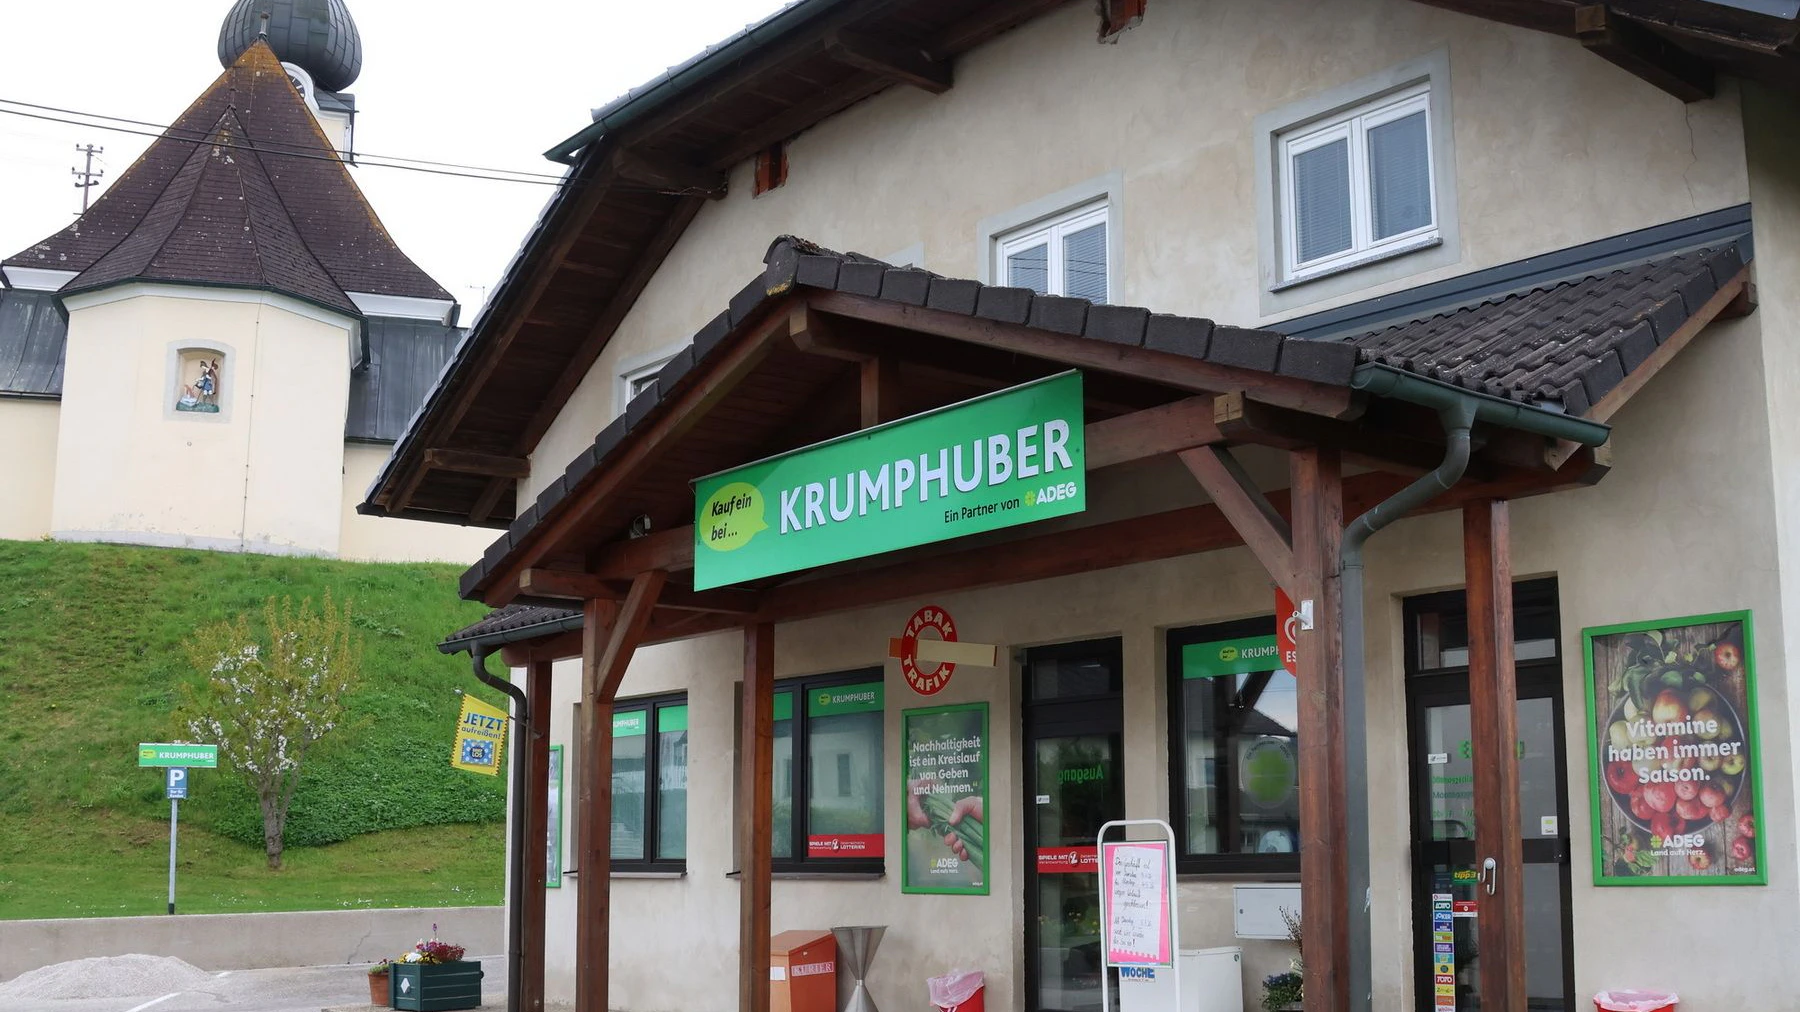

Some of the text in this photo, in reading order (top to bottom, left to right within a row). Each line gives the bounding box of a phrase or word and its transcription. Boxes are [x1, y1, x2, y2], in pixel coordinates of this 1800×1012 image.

[780, 419, 1073, 534] KRUMPHUBER
[944, 482, 1077, 523] Ein Partner von ADEG
[905, 609, 953, 638] TABAK
[903, 654, 950, 691] TRAFIK
[832, 691, 875, 704] KRUMPHUBER
[463, 712, 503, 731] JETZT
[1625, 715, 1718, 738] Vitamine
[461, 726, 501, 739] aufreißen!
[159, 751, 214, 759] KRUMPHUBER
[909, 751, 980, 767] ist ein Kreislauf
[1608, 739, 1741, 762] haben immer
[169, 769, 185, 787] P
[919, 767, 968, 780] von Geben
[1638, 763, 1711, 784] Saison.
[913, 783, 930, 795] und
[1662, 834, 1705, 848] ADEG
[936, 858, 958, 868] ADEG
[1120, 967, 1155, 978] WOCHE
